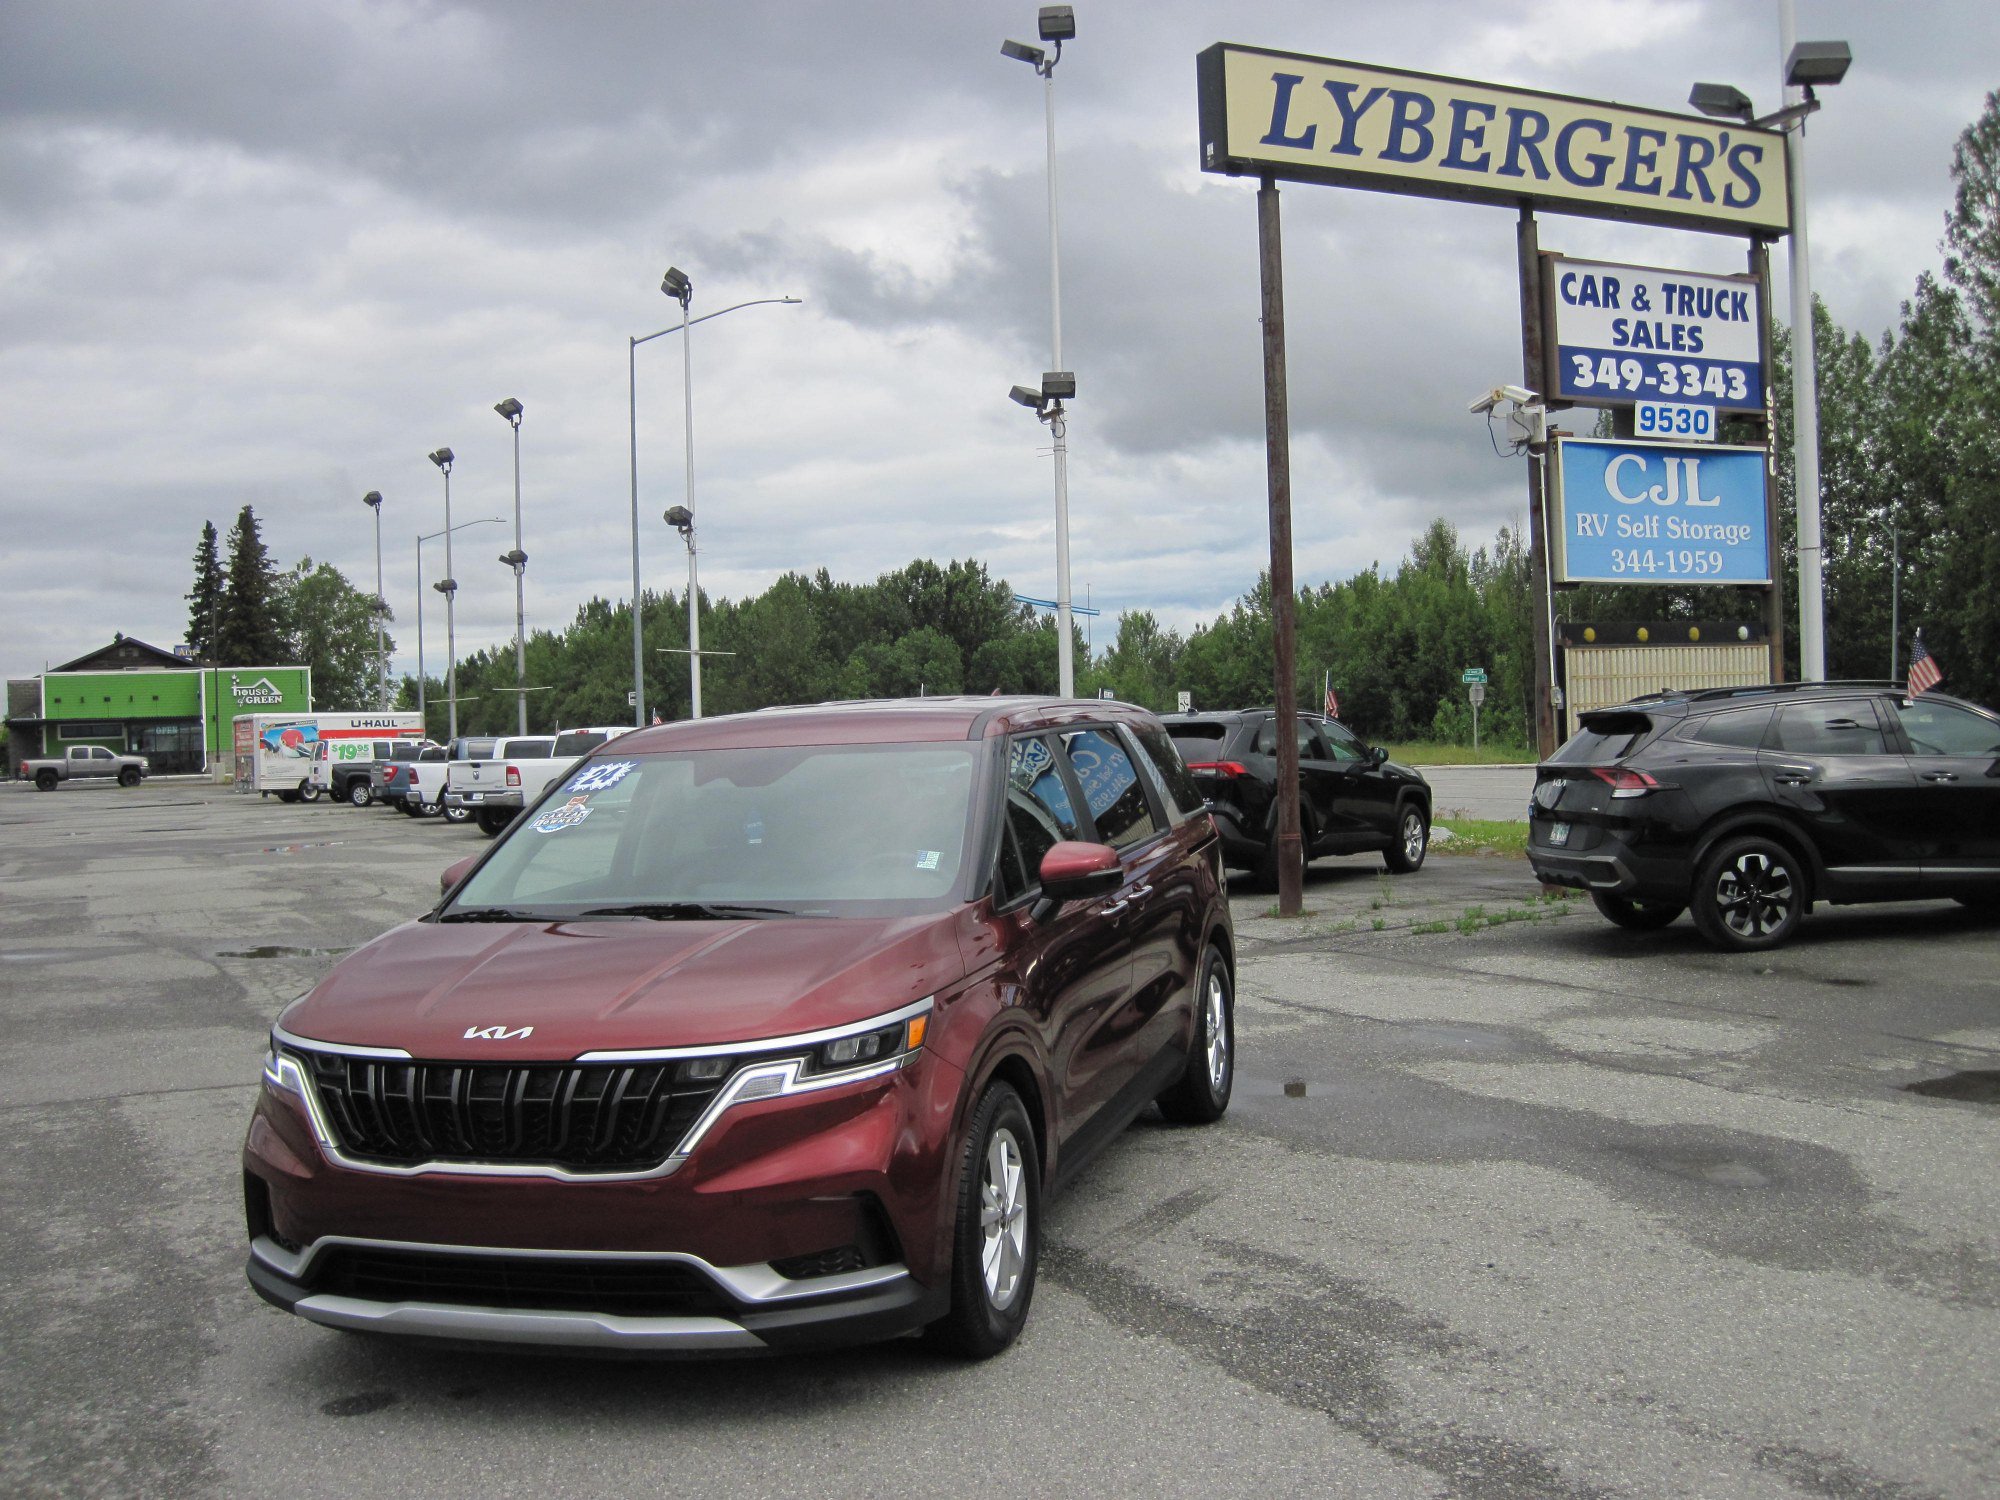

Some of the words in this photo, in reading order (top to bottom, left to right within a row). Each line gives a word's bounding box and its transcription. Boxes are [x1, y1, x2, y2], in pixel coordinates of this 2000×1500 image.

[1260, 72, 1764, 209] LYBERGER'S
[1561, 272, 1620, 309] CAR
[1631, 284, 1651, 312] &
[1662, 283, 1749, 322] TRUCK
[1612, 318, 1703, 353] SALES
[1572, 355, 1747, 399] 349-3343
[1640, 406, 1709, 435] 9530
[1604, 454, 1720, 506] CJL
[1576, 513, 1608, 536] RV
[1617, 514, 1659, 538] Self
[1666, 516, 1751, 545] Storage
[1611, 549, 1723, 573] 344-1959
[233, 686, 268, 696] house
[246, 695, 283, 704] GREEN
[351, 720, 398, 728] U-HAUL
[463, 1026, 535, 1040] KIA
